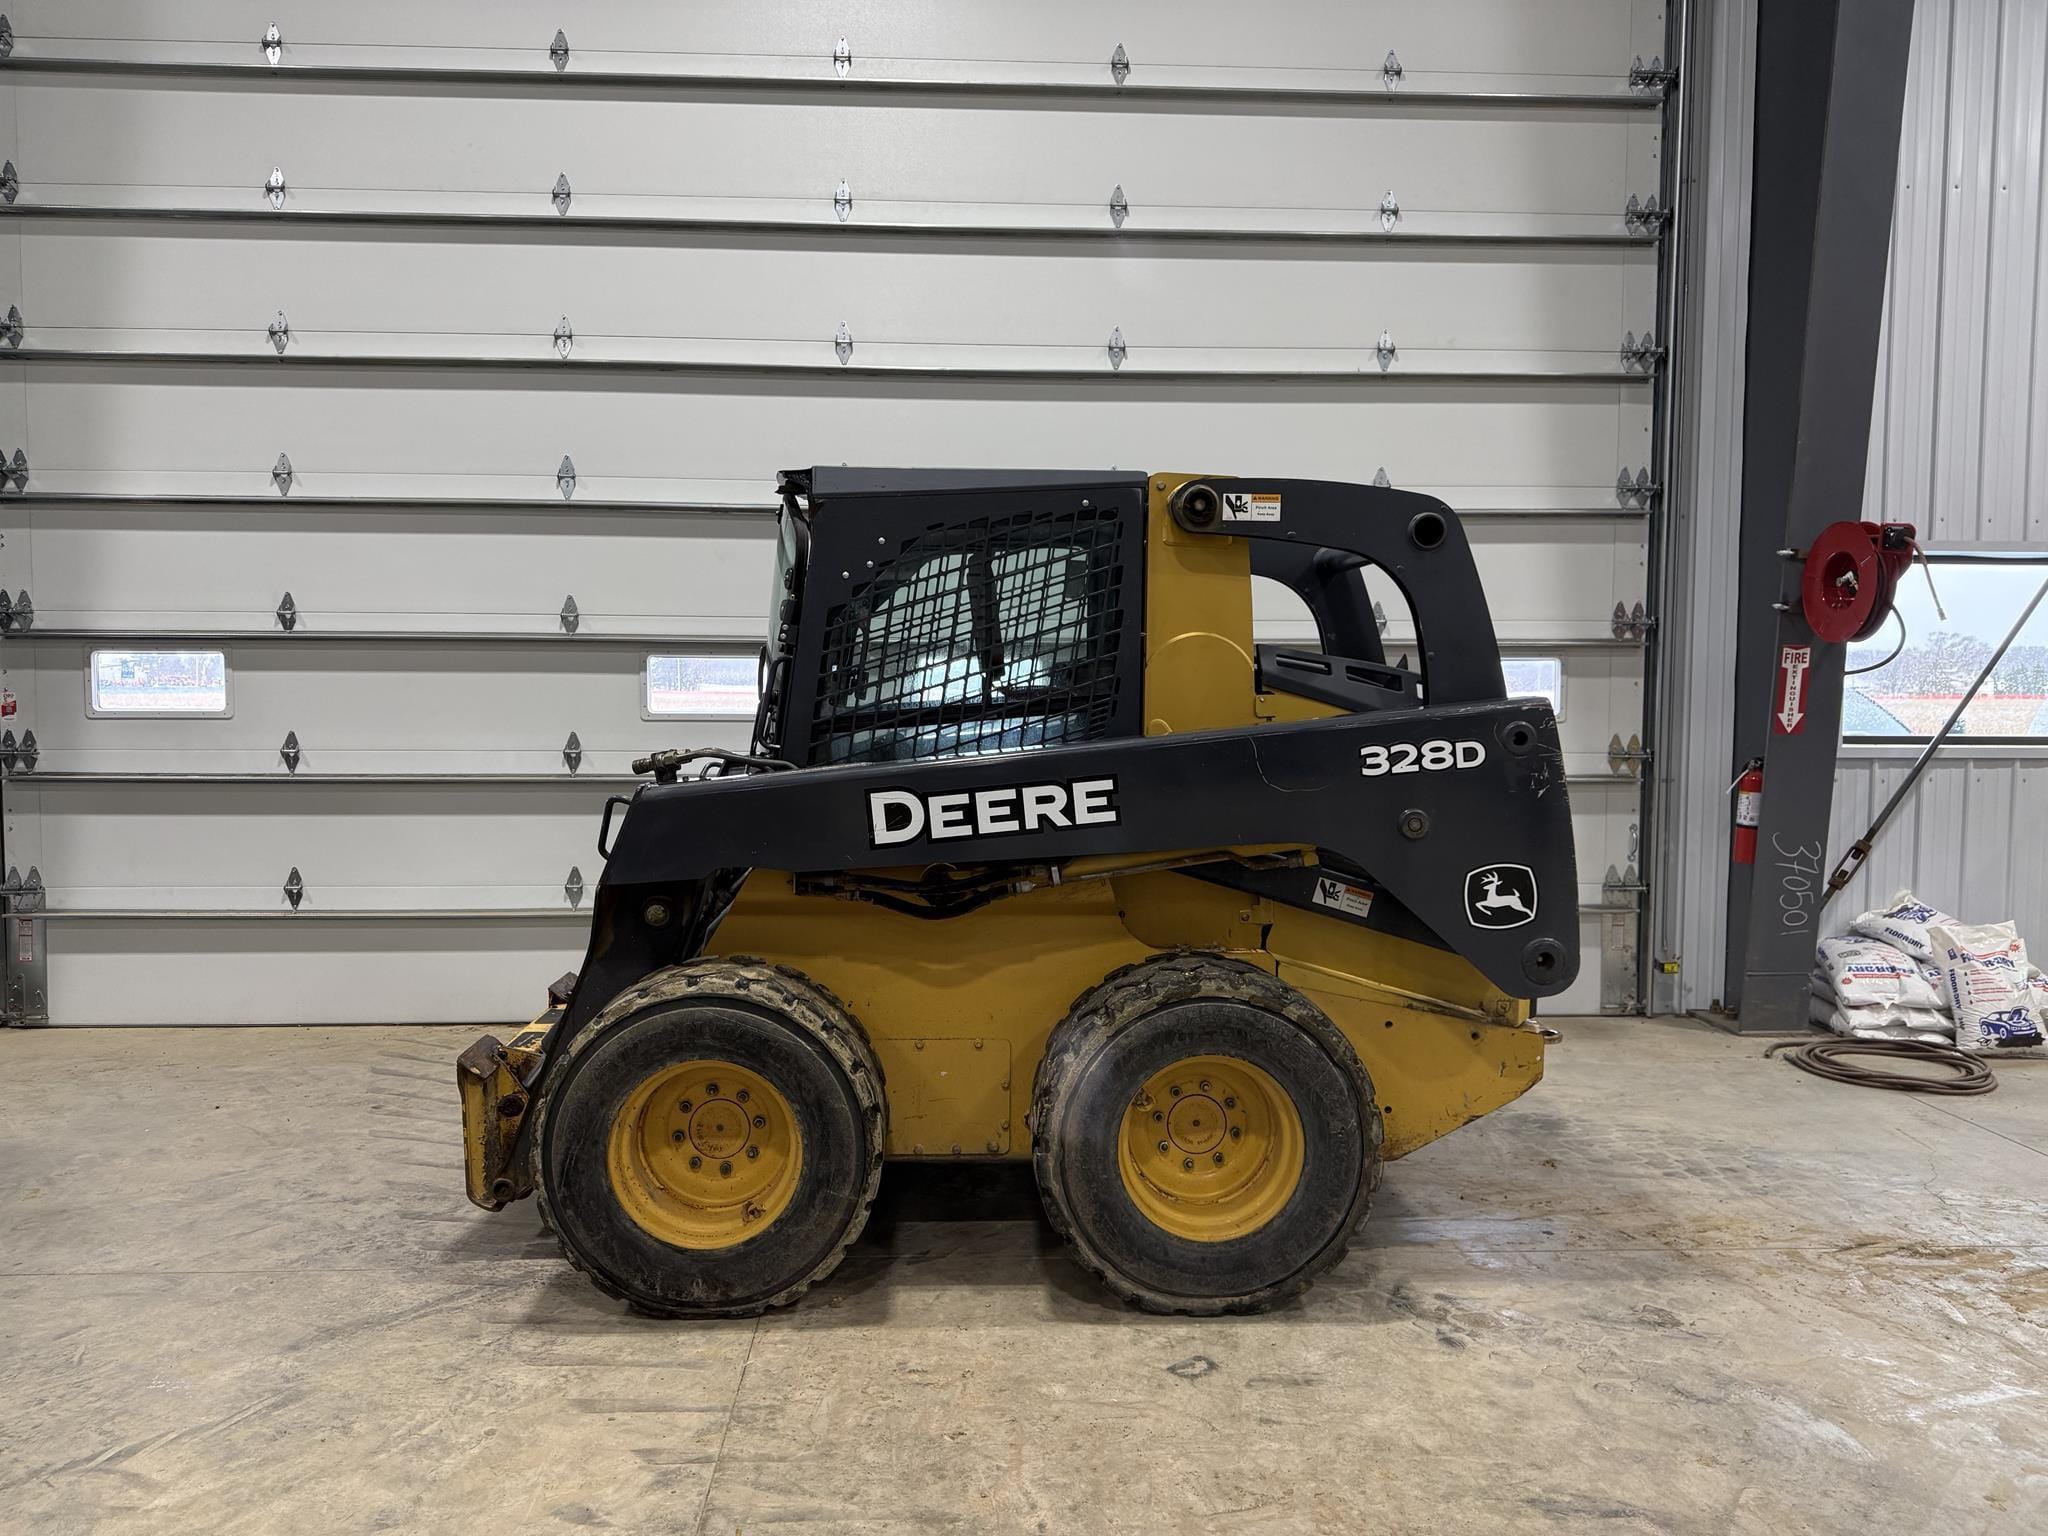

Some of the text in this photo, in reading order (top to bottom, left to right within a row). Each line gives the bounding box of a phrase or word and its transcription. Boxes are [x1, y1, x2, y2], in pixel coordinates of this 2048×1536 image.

[1784, 652, 1808, 664] FIRE
[1786, 664, 1798, 728] EXTINGUISHER
[1360, 740, 1486, 776] 328D
[870, 779, 1117, 845] DEERE
[1772, 832, 1822, 936] 370501
